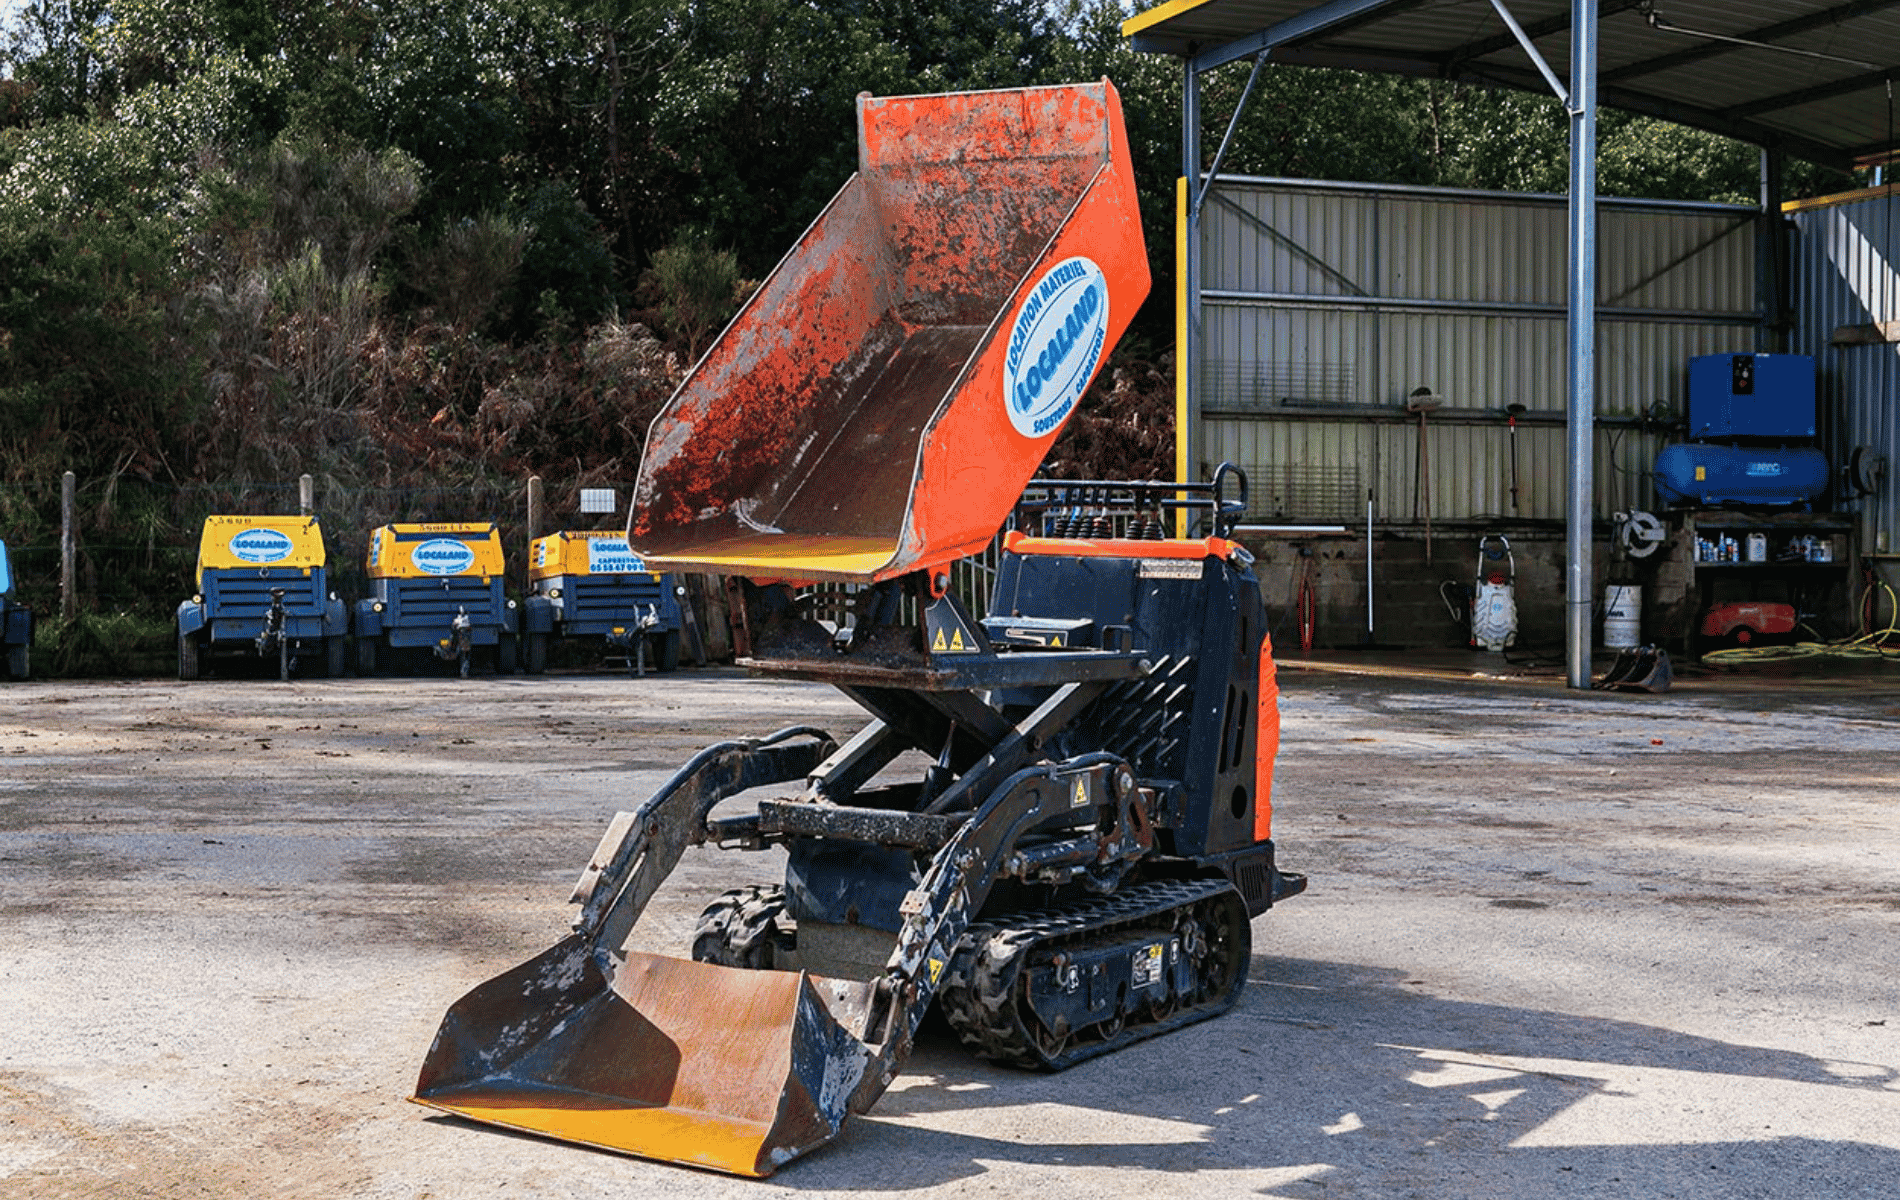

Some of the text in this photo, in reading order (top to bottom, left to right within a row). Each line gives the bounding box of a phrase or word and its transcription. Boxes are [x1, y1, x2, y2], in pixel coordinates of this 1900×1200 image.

[1008, 260, 1087, 376] LOCATION MATERIEL
[1016, 284, 1099, 412] LOCALAND
[1033, 327, 1105, 434] SOUSTONS CAPBRETON
[235, 540, 289, 550] LOCALAND
[417, 550, 469, 560] LOCALAND
